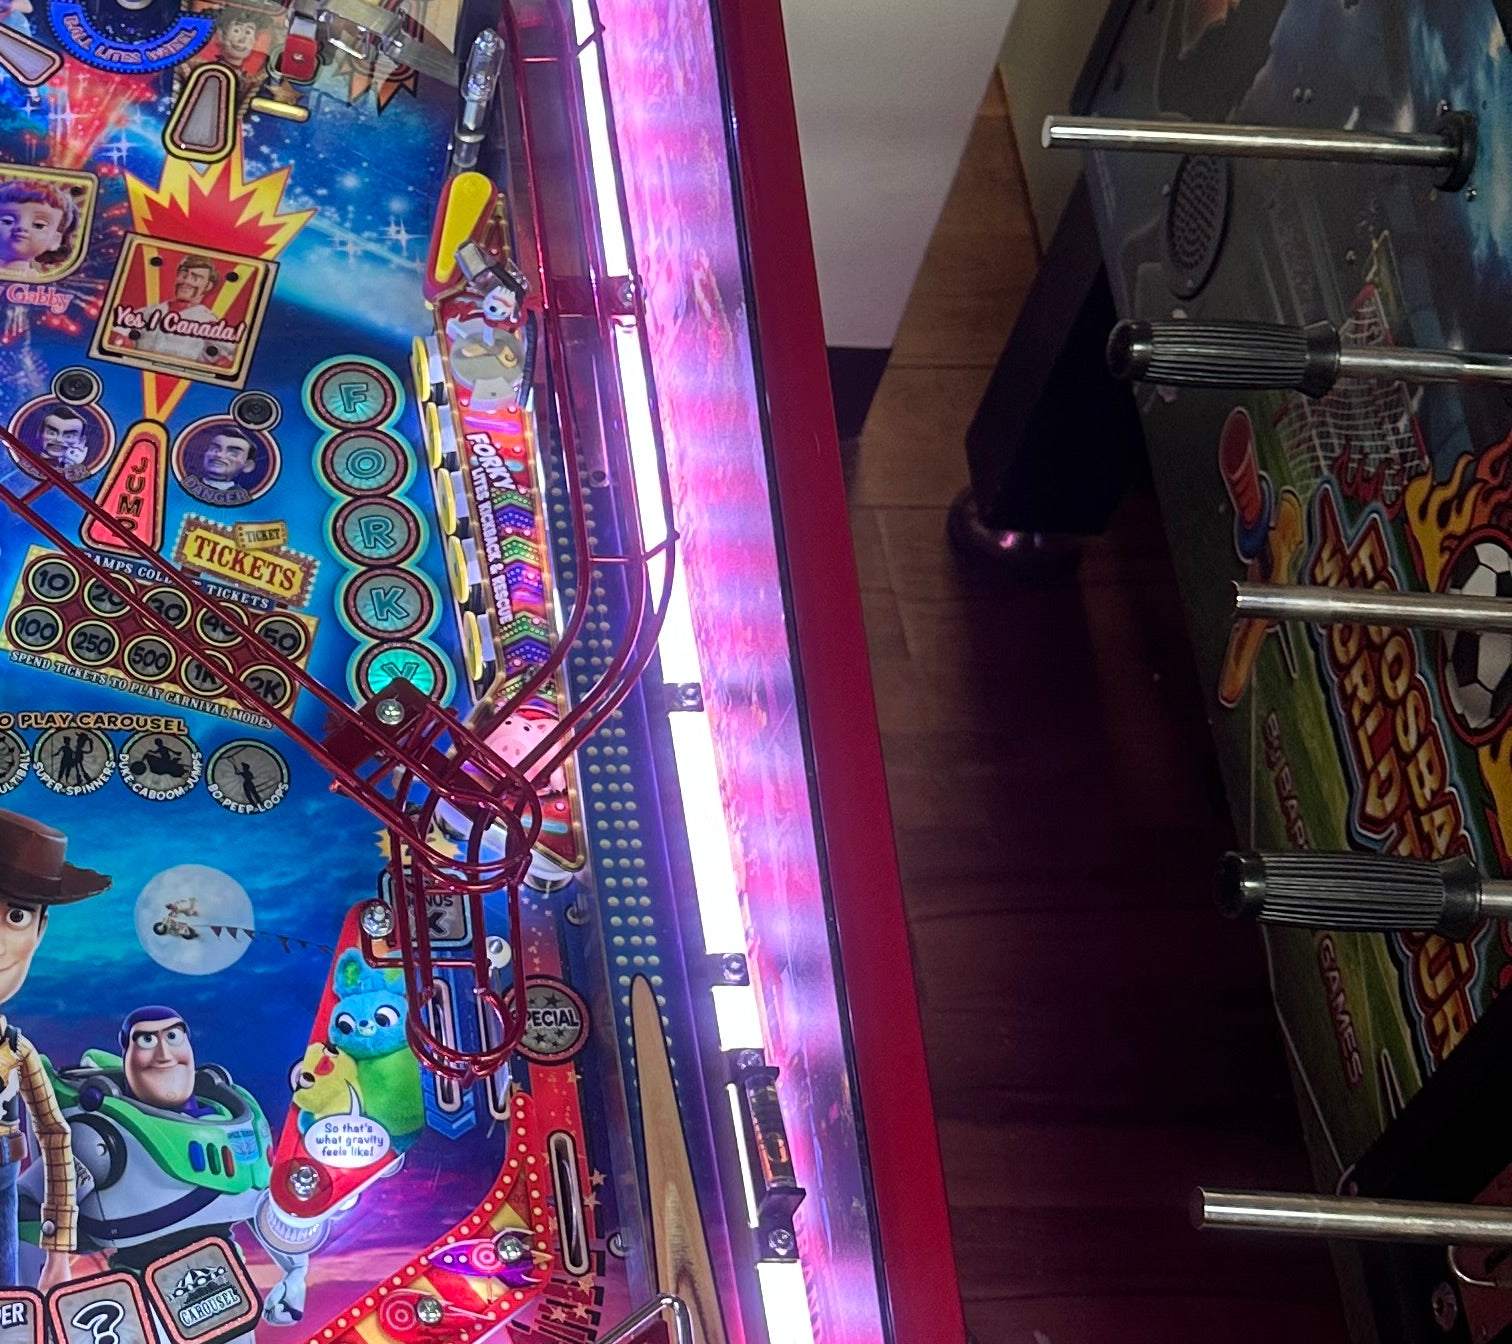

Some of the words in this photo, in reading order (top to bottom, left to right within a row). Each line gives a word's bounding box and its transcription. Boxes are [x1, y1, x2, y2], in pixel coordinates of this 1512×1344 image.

[6, 282, 74, 314] Gabby
[114, 305, 147, 330] Yes
[160, 311, 246, 343] Canada!
[464, 431, 516, 490] FORKY
[181, 474, 255, 506] DANGER
[470, 466, 490, 501] LITES
[245, 528, 282, 543] TICKET
[478, 500, 503, 564] KICKBACK
[86, 551, 133, 574] AMPS
[207, 582, 271, 610] TICKETS
[193, 534, 299, 591] TICKETS
[38, 569, 71, 590] 10
[261, 626, 298, 650] 50
[491, 573, 514, 626] RESCUE
[17, 616, 56, 639] 100
[75, 632, 112, 654] 250
[131, 646, 170, 669] 500
[9, 650, 52, 672] SPEND
[54, 662, 107, 687] TICKETS
[109, 676, 129, 692] TO
[130, 682, 164, 704] PLAY
[164, 690, 230, 719] CARNIVAL
[231, 708, 275, 730] MODES
[17, 711, 74, 730] PLAY
[76, 712, 188, 736] CAROUSEL
[1315, 928, 1364, 1086] GAMES
[315, 1134, 343, 1145] what
[345, 1135, 384, 1148] gravity
[324, 1122, 339, 1134] So
[342, 1122, 374, 1134] that's
[321, 1147, 348, 1157] feels
[350, 1146, 375, 1157] like!
[178, 1286, 239, 1329] CAROUSEL
